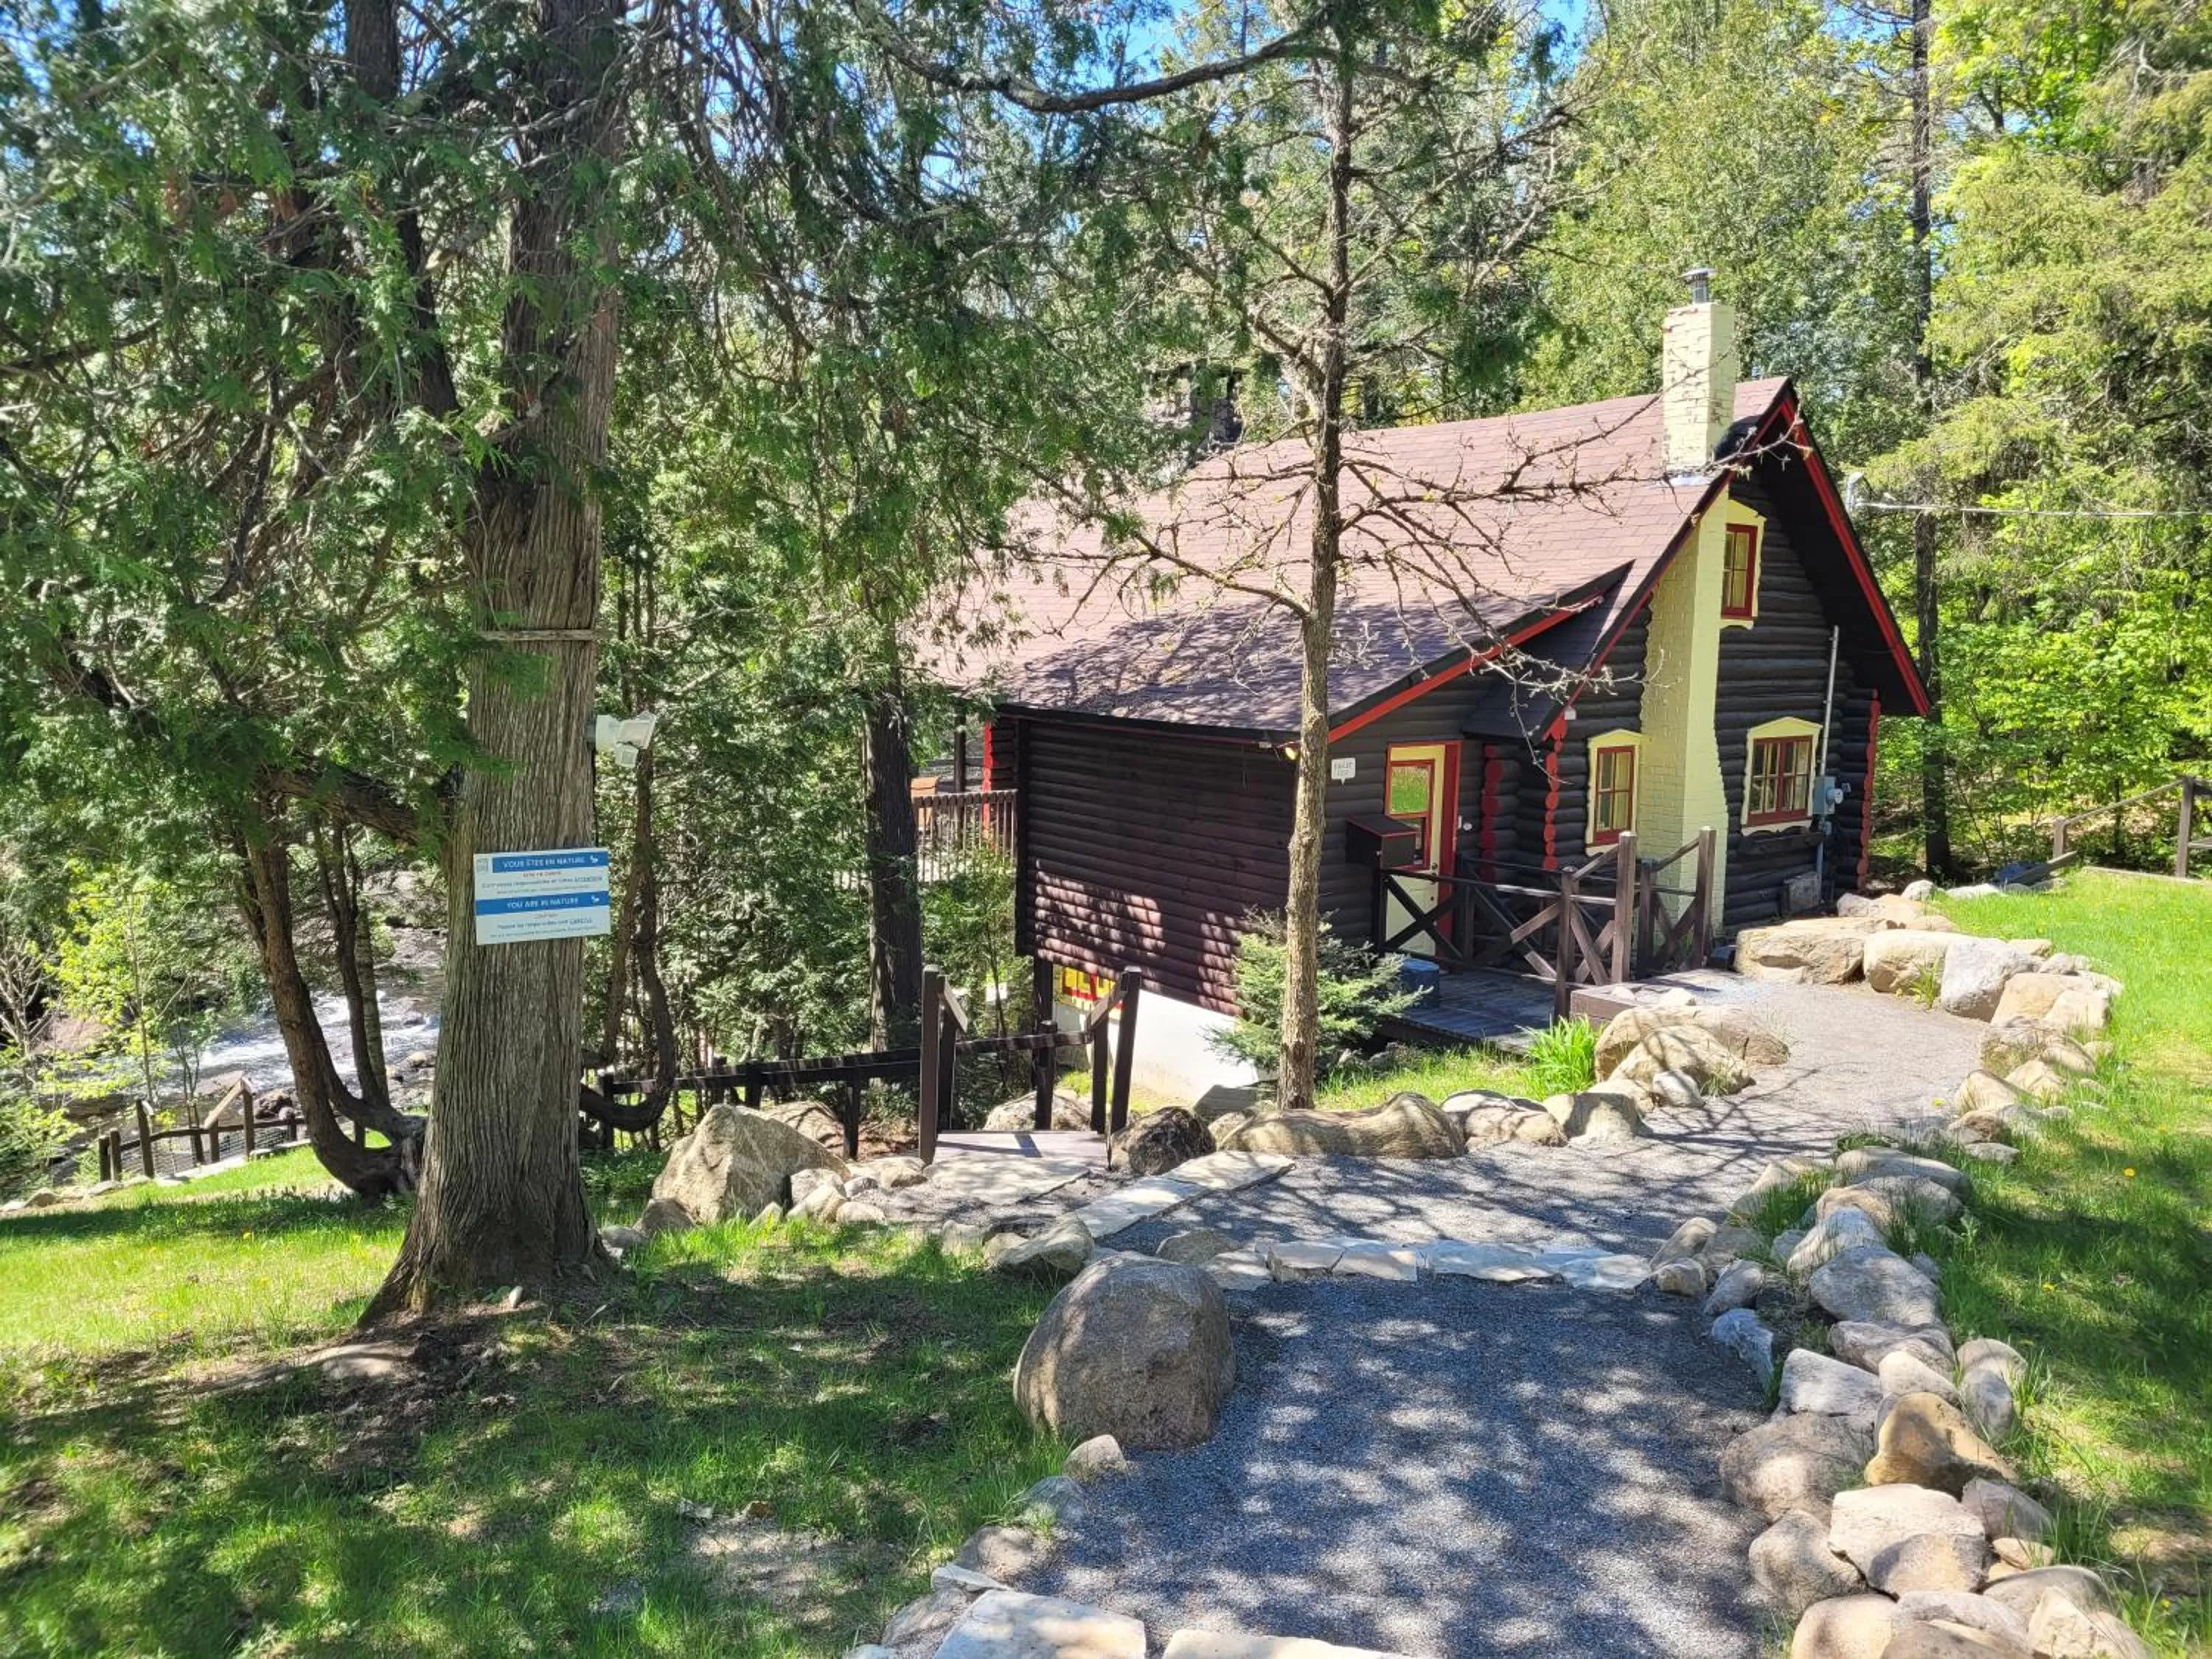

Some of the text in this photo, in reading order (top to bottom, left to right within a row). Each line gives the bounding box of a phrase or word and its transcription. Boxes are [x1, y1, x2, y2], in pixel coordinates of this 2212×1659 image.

[545, 857, 556, 866] EN
[556, 856, 585, 866] NATURE
[507, 901, 523, 909] YOU
[524, 900, 539, 908] ARE
[549, 897, 579, 907] NATURE
